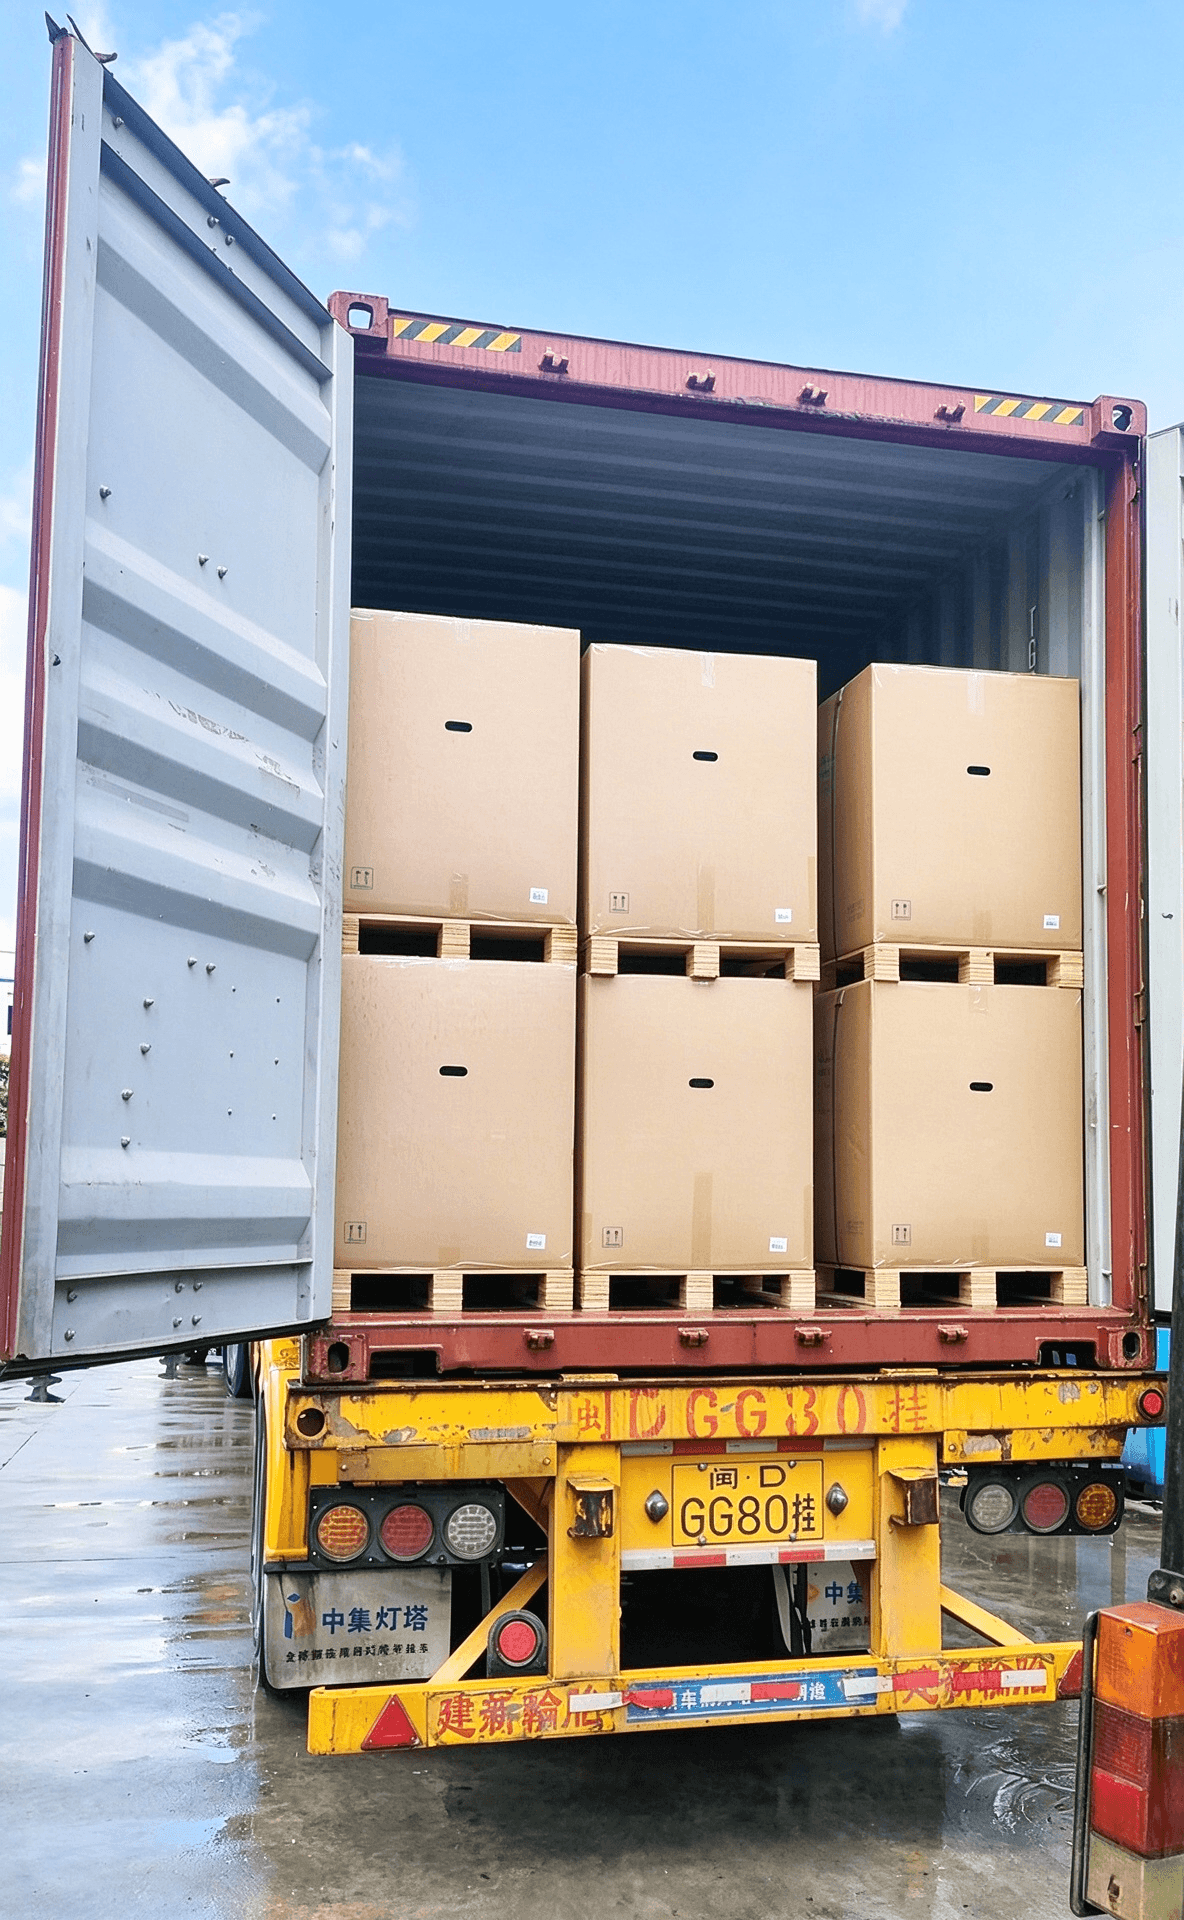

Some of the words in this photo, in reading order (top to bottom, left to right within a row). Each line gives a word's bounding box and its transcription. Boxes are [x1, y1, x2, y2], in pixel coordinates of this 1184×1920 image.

[681, 1493, 816, 1537] GG80挂
[322, 1605, 428, 1635] 中集灯塔
